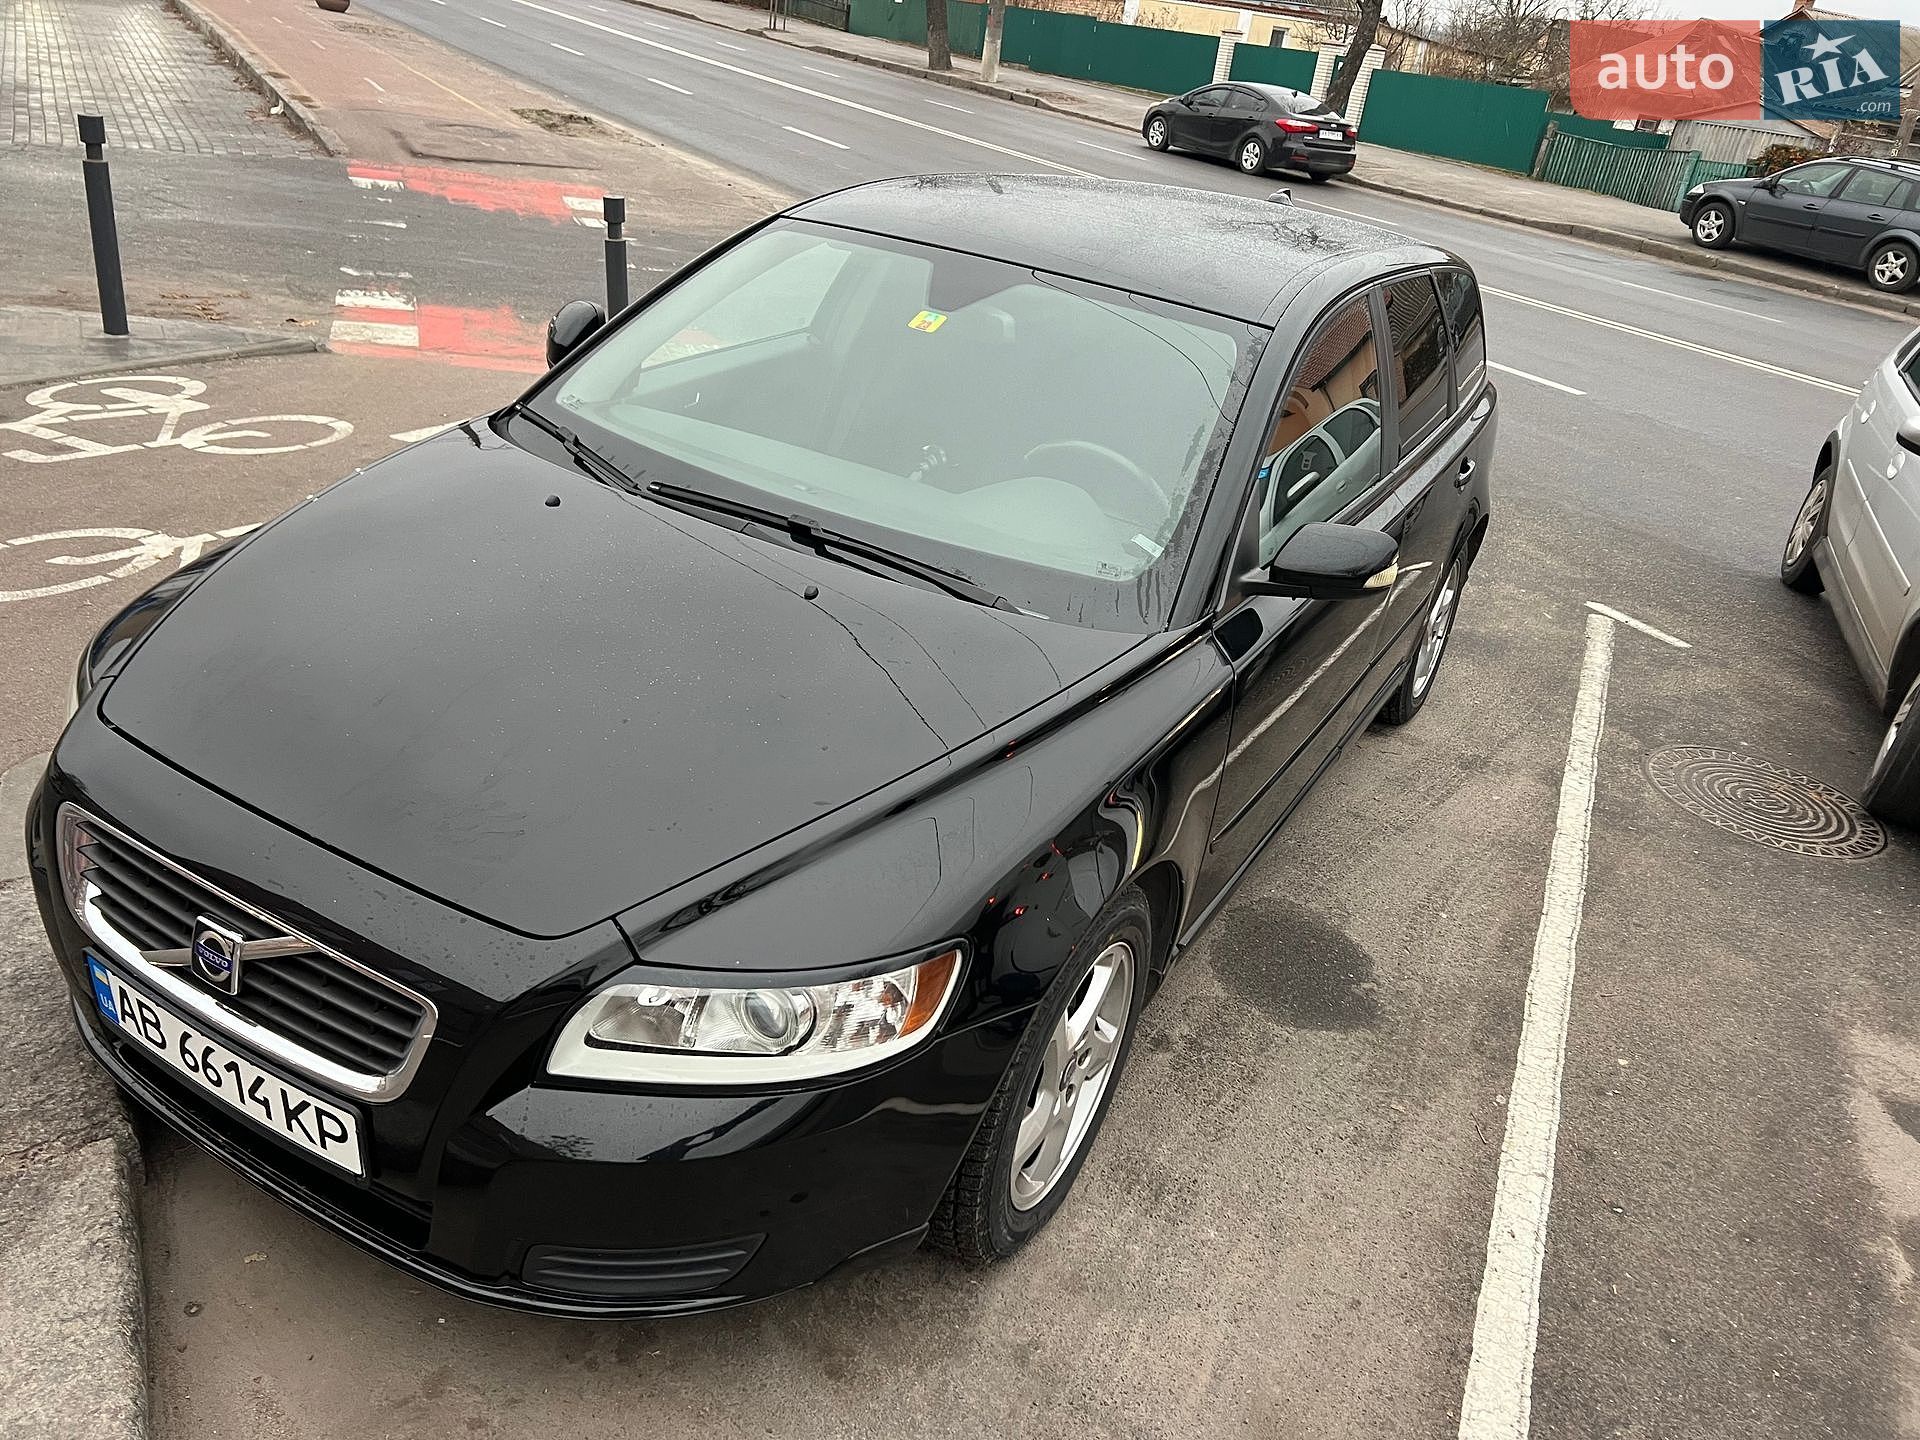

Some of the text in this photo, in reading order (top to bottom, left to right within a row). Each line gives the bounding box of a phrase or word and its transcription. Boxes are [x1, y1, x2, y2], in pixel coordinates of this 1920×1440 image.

[197, 945, 228, 968] VOLVO
[99, 993, 116, 1014] UA
[118, 988, 348, 1150] AB 6614 KP
